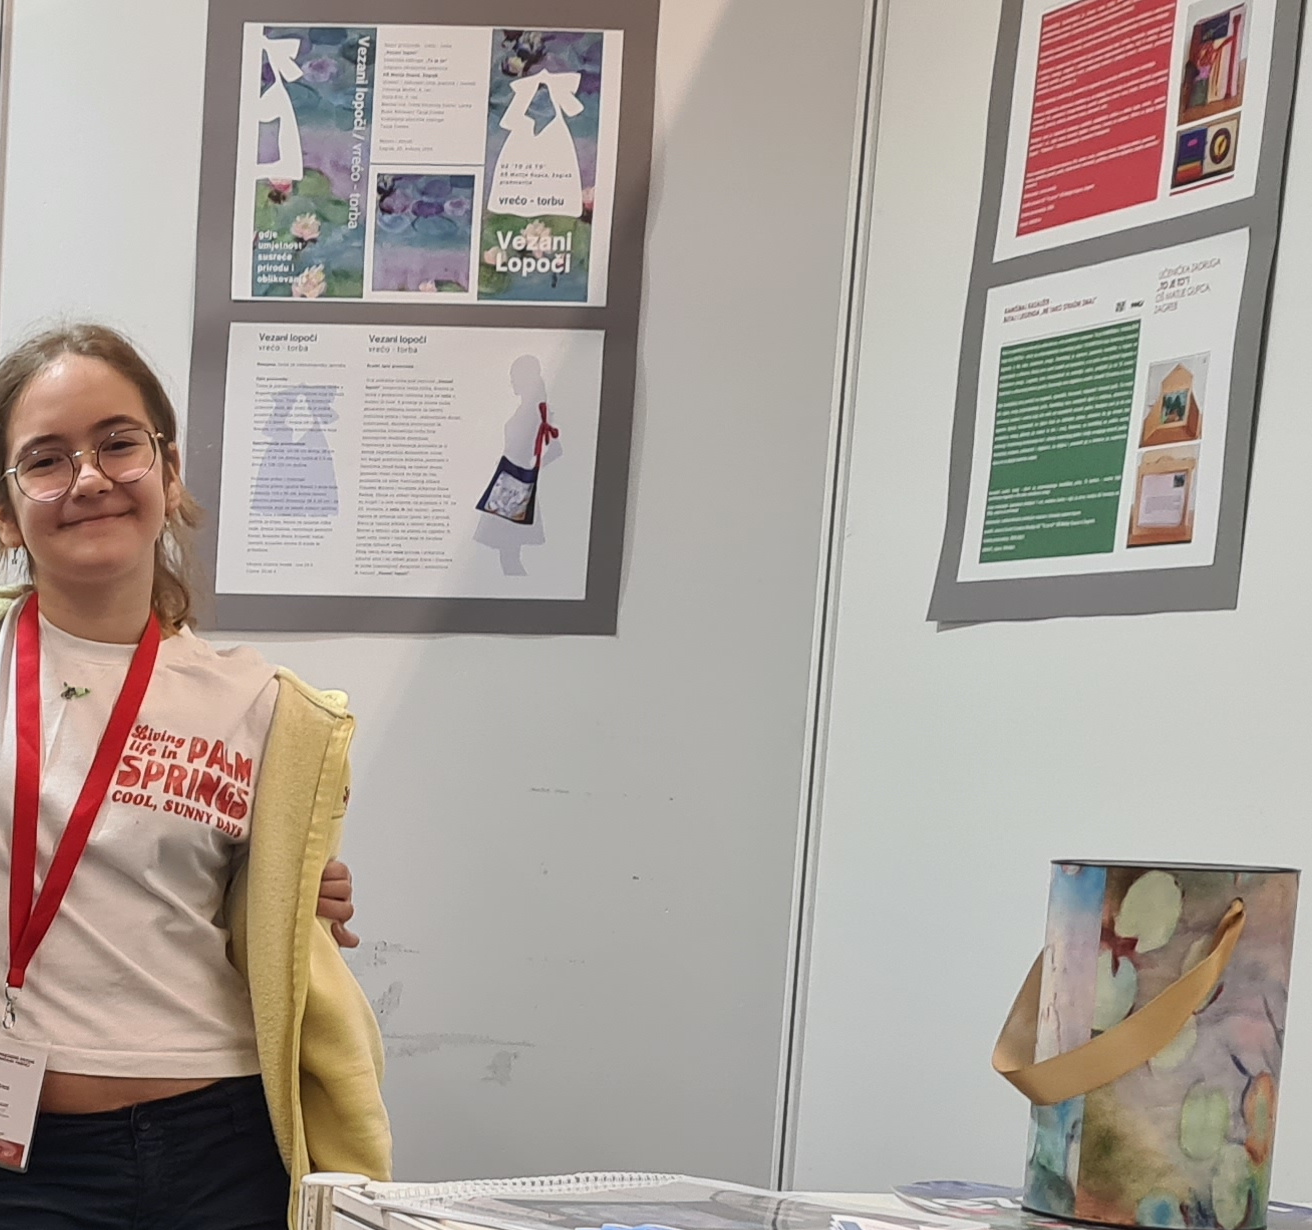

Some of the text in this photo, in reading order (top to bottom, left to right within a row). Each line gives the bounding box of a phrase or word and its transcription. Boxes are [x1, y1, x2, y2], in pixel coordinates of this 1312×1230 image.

[355, 35, 371, 84] Vezani
[350, 87, 368, 130] lopoči
[347, 193, 361, 229] torba
[258, 230, 278, 240] gdje
[258, 240, 303, 253] umjetnost
[496, 231, 572, 251] Vezani
[257, 263, 289, 273] prirodu
[496, 252, 571, 277] Lopoči
[259, 332, 317, 343] Vezani lopoči
[369, 334, 398, 344] Vezani
[131, 724, 187, 749] Living
[129, 740, 177, 759] life in
[187, 736, 253, 787] PALM
[116, 755, 249, 820] SPRINGS
[112, 790, 243, 839] COOL, SUNNY DAYS
